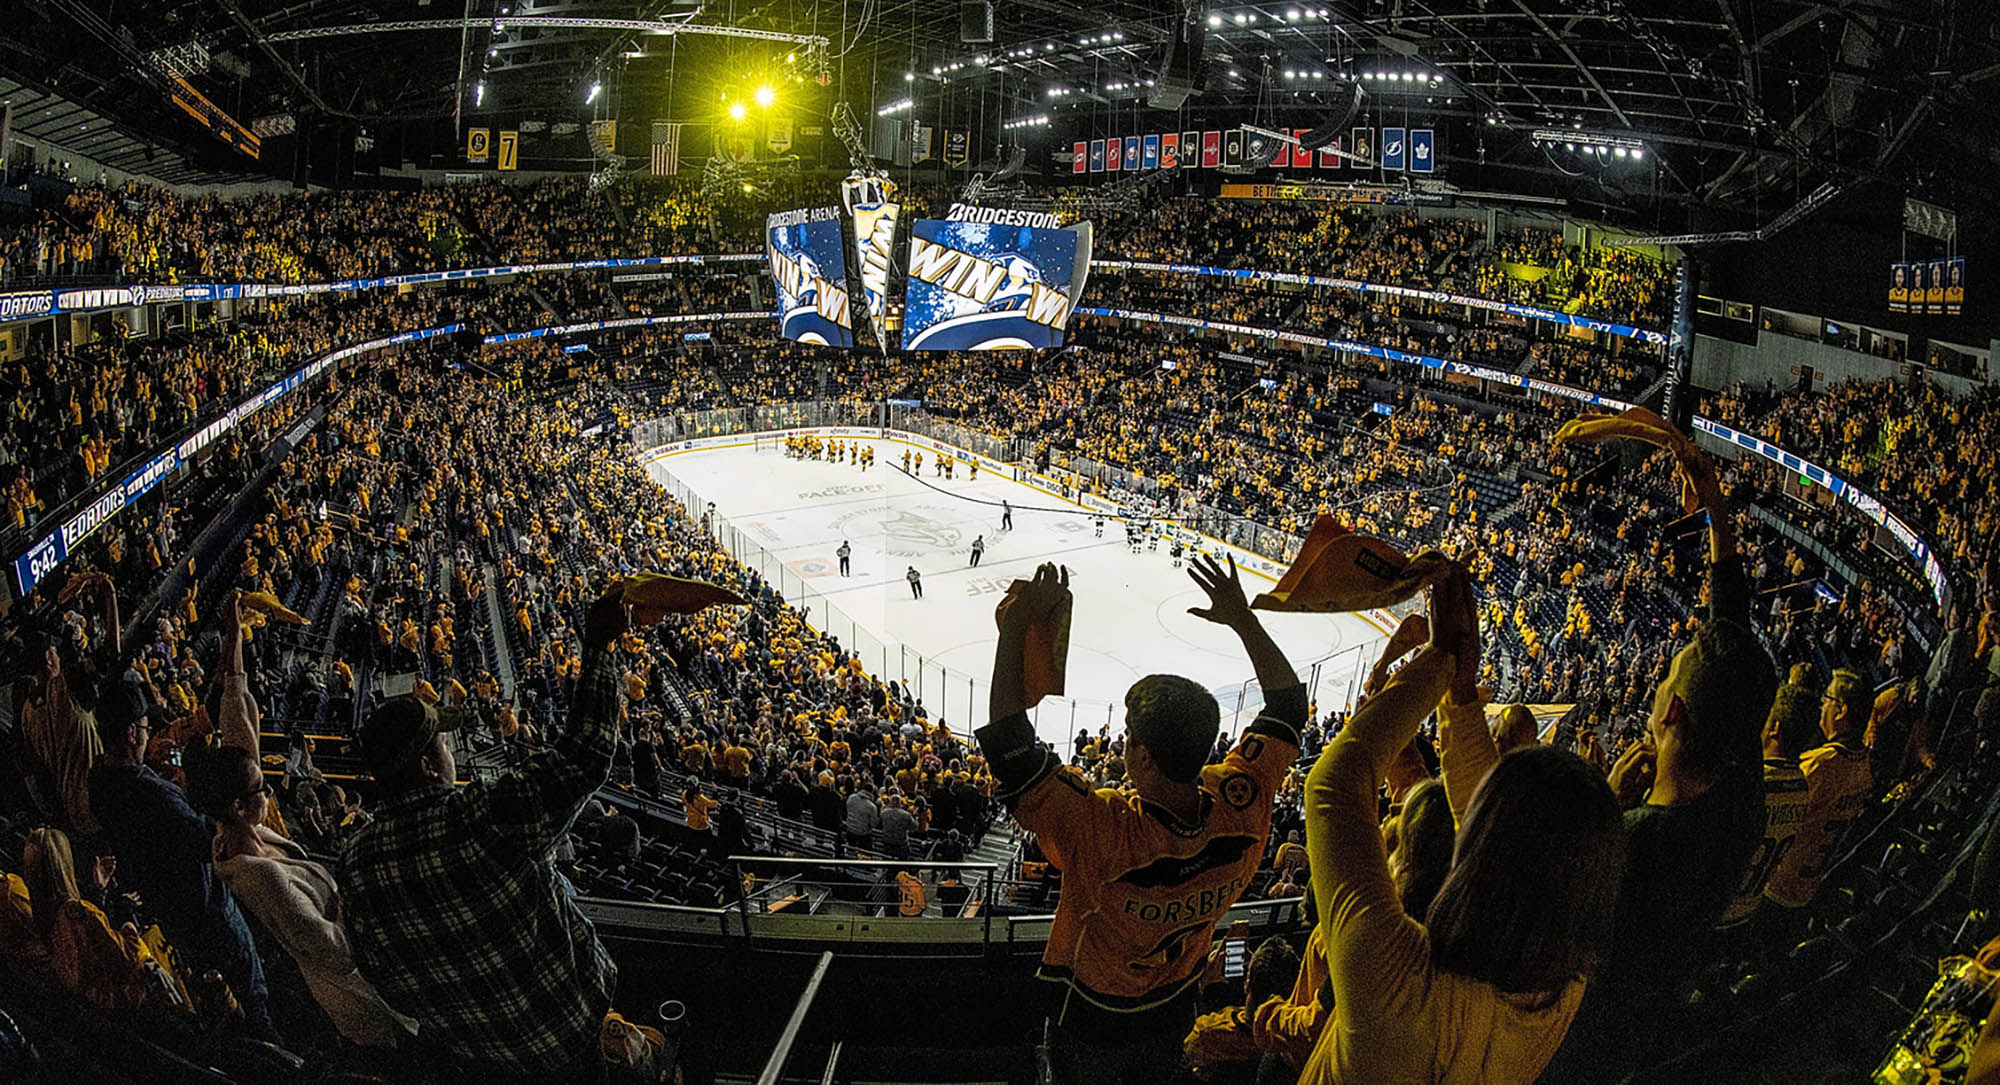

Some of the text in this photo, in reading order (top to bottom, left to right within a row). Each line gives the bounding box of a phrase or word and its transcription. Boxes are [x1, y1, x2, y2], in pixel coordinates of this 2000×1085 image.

[502, 137, 515, 167] 7
[810, 206, 841, 223] ARENA
[945, 202, 1063, 230] BRIDGESTONE
[770, 243, 800, 300] WIN
[909, 236, 1007, 304] WIN
[0, 294, 53, 316] DATORS
[1673, 266, 1684, 324] HEALTH
[30, 544, 59, 585] 9:42
